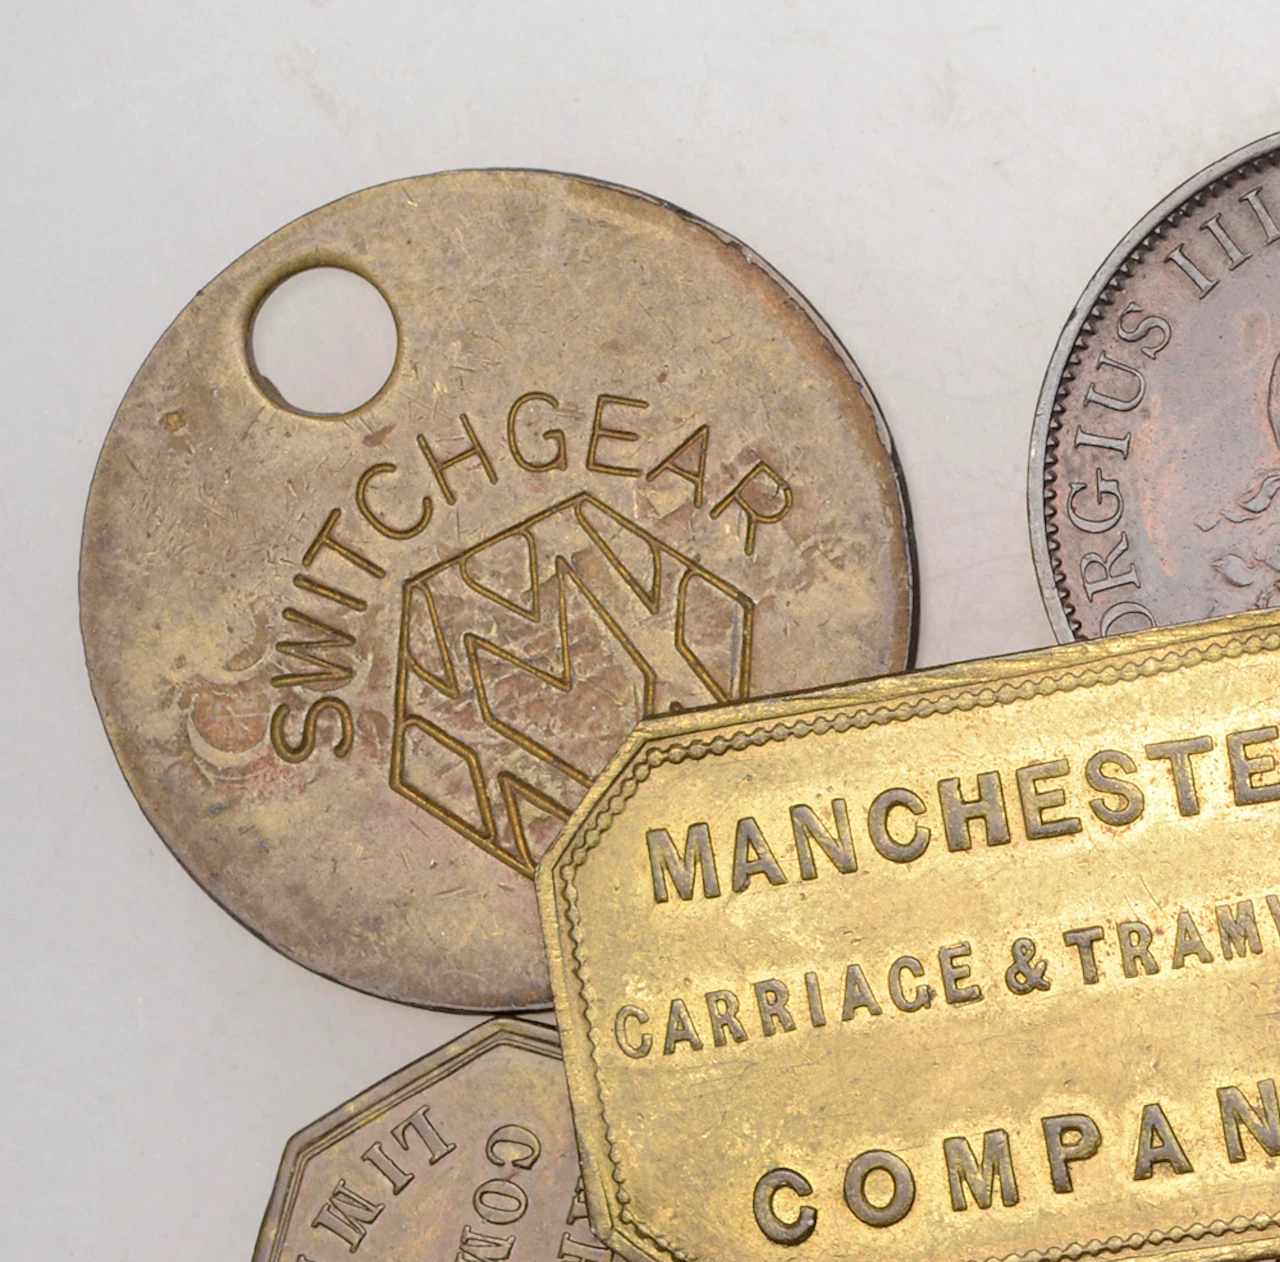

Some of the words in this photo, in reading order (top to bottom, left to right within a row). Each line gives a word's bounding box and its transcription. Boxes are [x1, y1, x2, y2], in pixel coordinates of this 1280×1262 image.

[269, 390, 795, 766] SWITCHGEAR
[614, 942, 982, 1058] CARRIAGE
[1003, 936, 1050, 996] &
